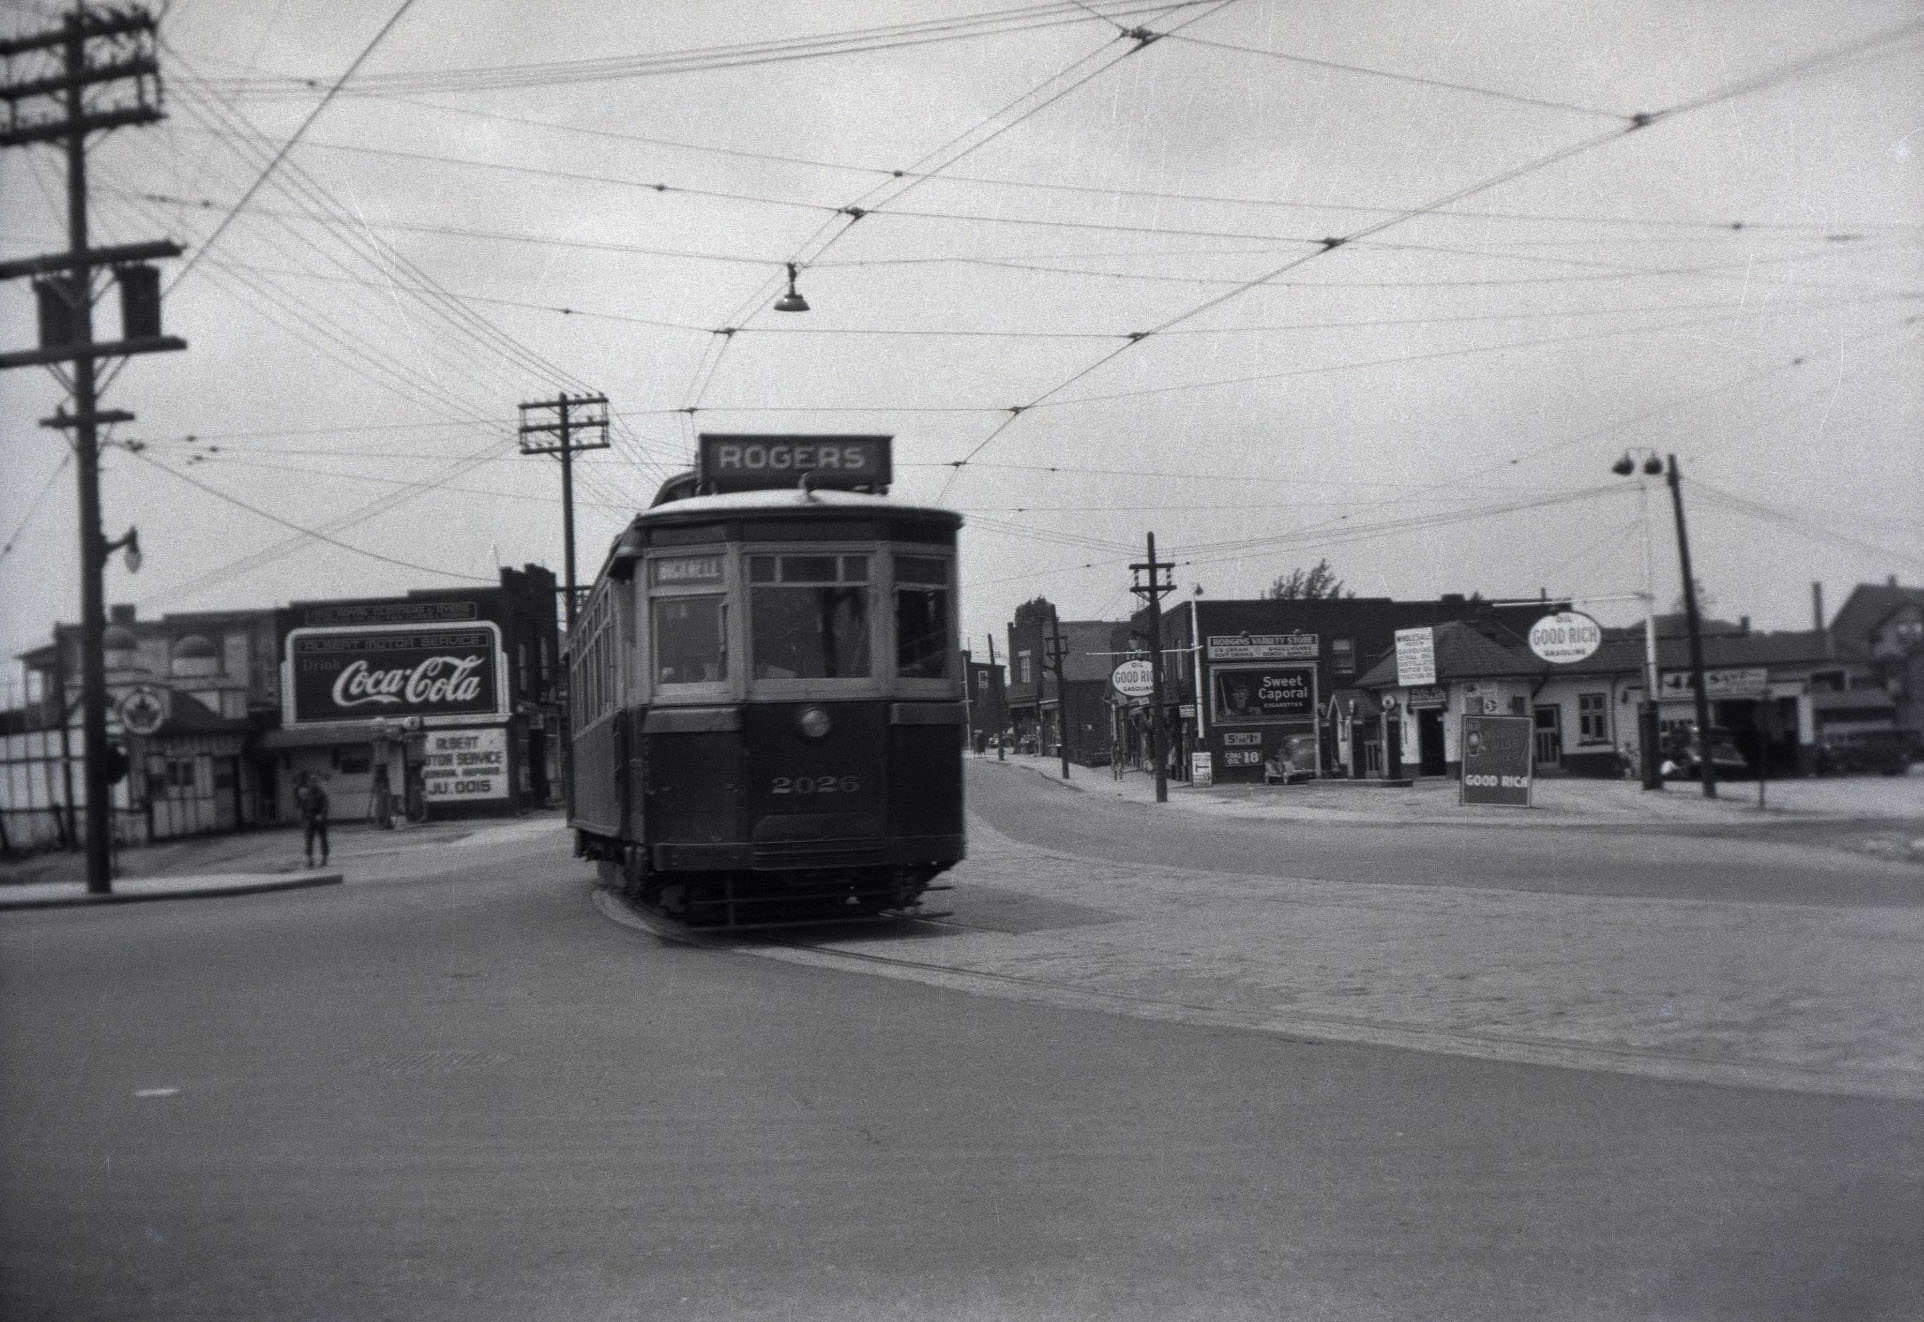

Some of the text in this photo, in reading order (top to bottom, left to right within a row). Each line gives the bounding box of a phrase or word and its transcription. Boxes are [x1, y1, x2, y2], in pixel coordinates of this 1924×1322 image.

[719, 445, 866, 469] ROGERS
[420, 635, 479, 647] SERVICE
[1533, 627, 1598, 645] GOOD RICH
[303, 658, 342, 671] Drink
[1115, 671, 1139, 683] GOOD
[1263, 675, 1303, 688] Sweet
[1258, 687, 1308, 701] Caporal
[456, 751, 502, 766] SERVICE
[771, 775, 860, 793] 2026
[1465, 774, 1499, 787] GOOD
